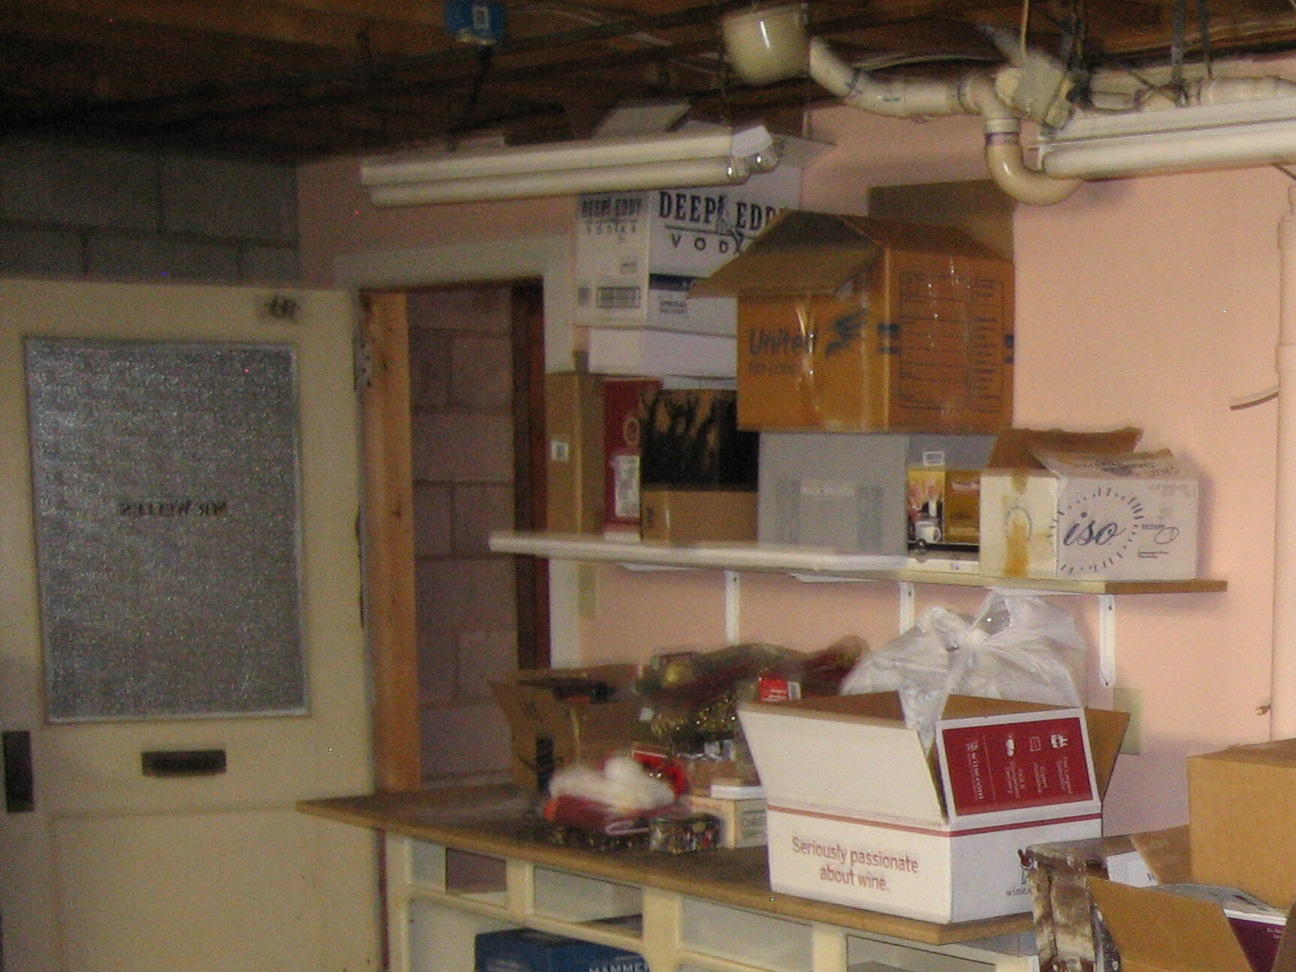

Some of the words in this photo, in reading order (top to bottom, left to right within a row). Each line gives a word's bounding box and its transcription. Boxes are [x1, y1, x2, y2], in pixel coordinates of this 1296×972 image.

[659, 191, 716, 224] DEEP
[736, 201, 777, 231] EDD
[671, 233, 729, 254] VOD
[1063, 511, 1126, 546] iso
[792, 836, 848, 865] Seriously
[849, 848, 919, 873] passionate
[819, 864, 855, 885] about
[858, 872, 890, 893] wine.
